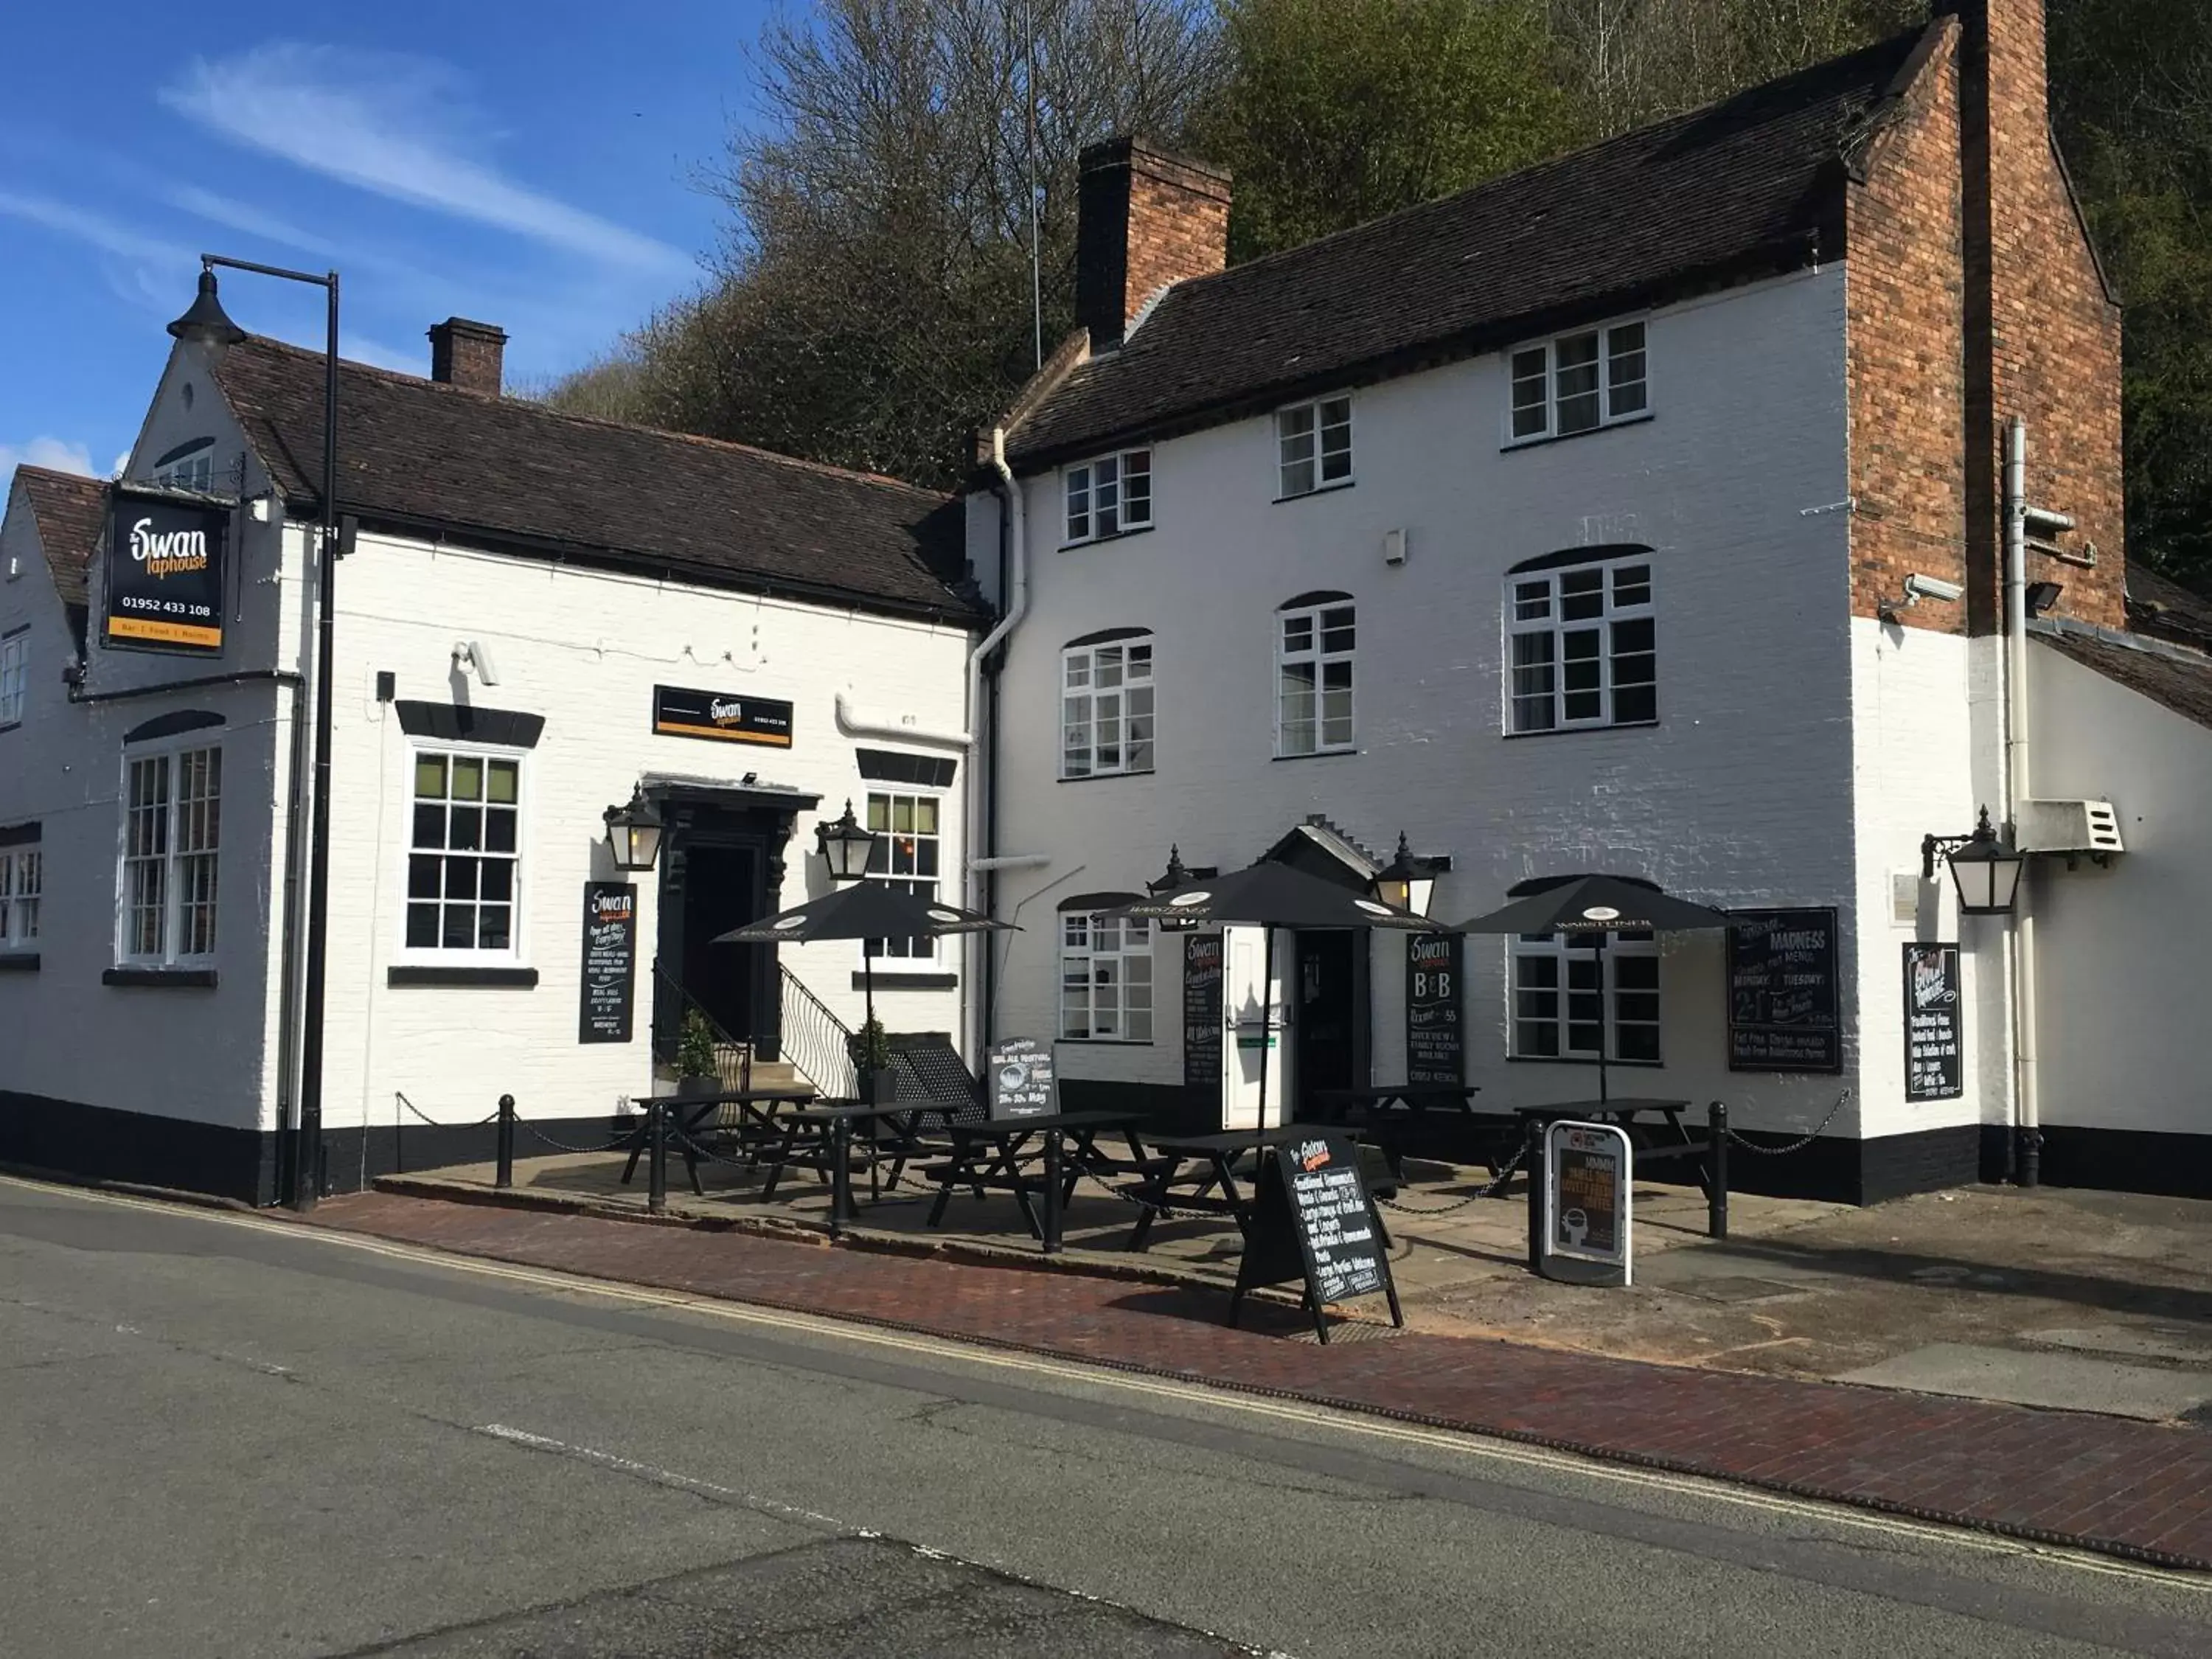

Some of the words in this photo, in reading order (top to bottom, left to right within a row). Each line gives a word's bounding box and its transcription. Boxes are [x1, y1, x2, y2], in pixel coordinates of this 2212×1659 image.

[131, 518, 207, 560] Swan
[123, 597, 160, 611] 01952
[163, 602, 185, 613] 433
[189, 605, 210, 616] 108
[711, 698, 741, 719] Swan
[592, 889, 631, 914] Swan
[1189, 937, 1220, 960] Swan
[1411, 936, 1450, 961] Swan
[1770, 930, 1825, 950] MADNESS
